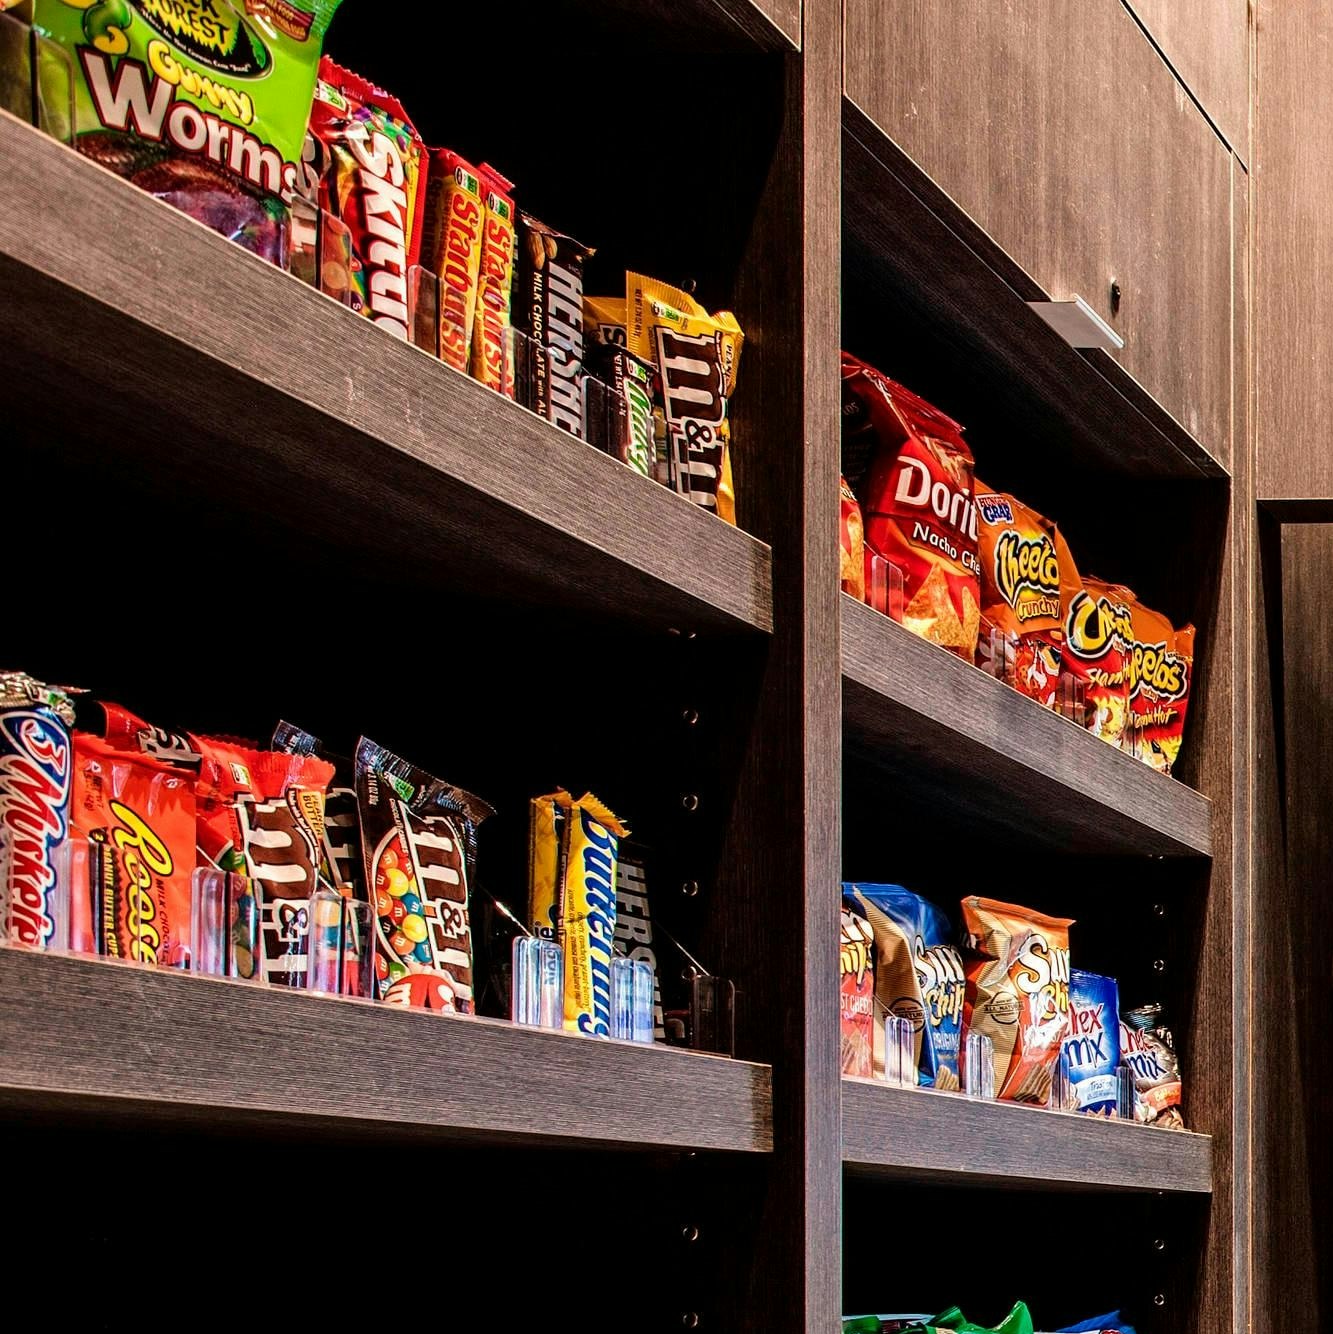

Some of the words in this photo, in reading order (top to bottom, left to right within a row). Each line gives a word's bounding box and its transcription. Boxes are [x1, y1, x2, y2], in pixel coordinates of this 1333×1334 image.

[148, 40, 254, 125] Gummy
[532, 272, 544, 309] MILK
[912, 522, 957, 558] Nacho
[104, 883, 118, 935] BUTTER
